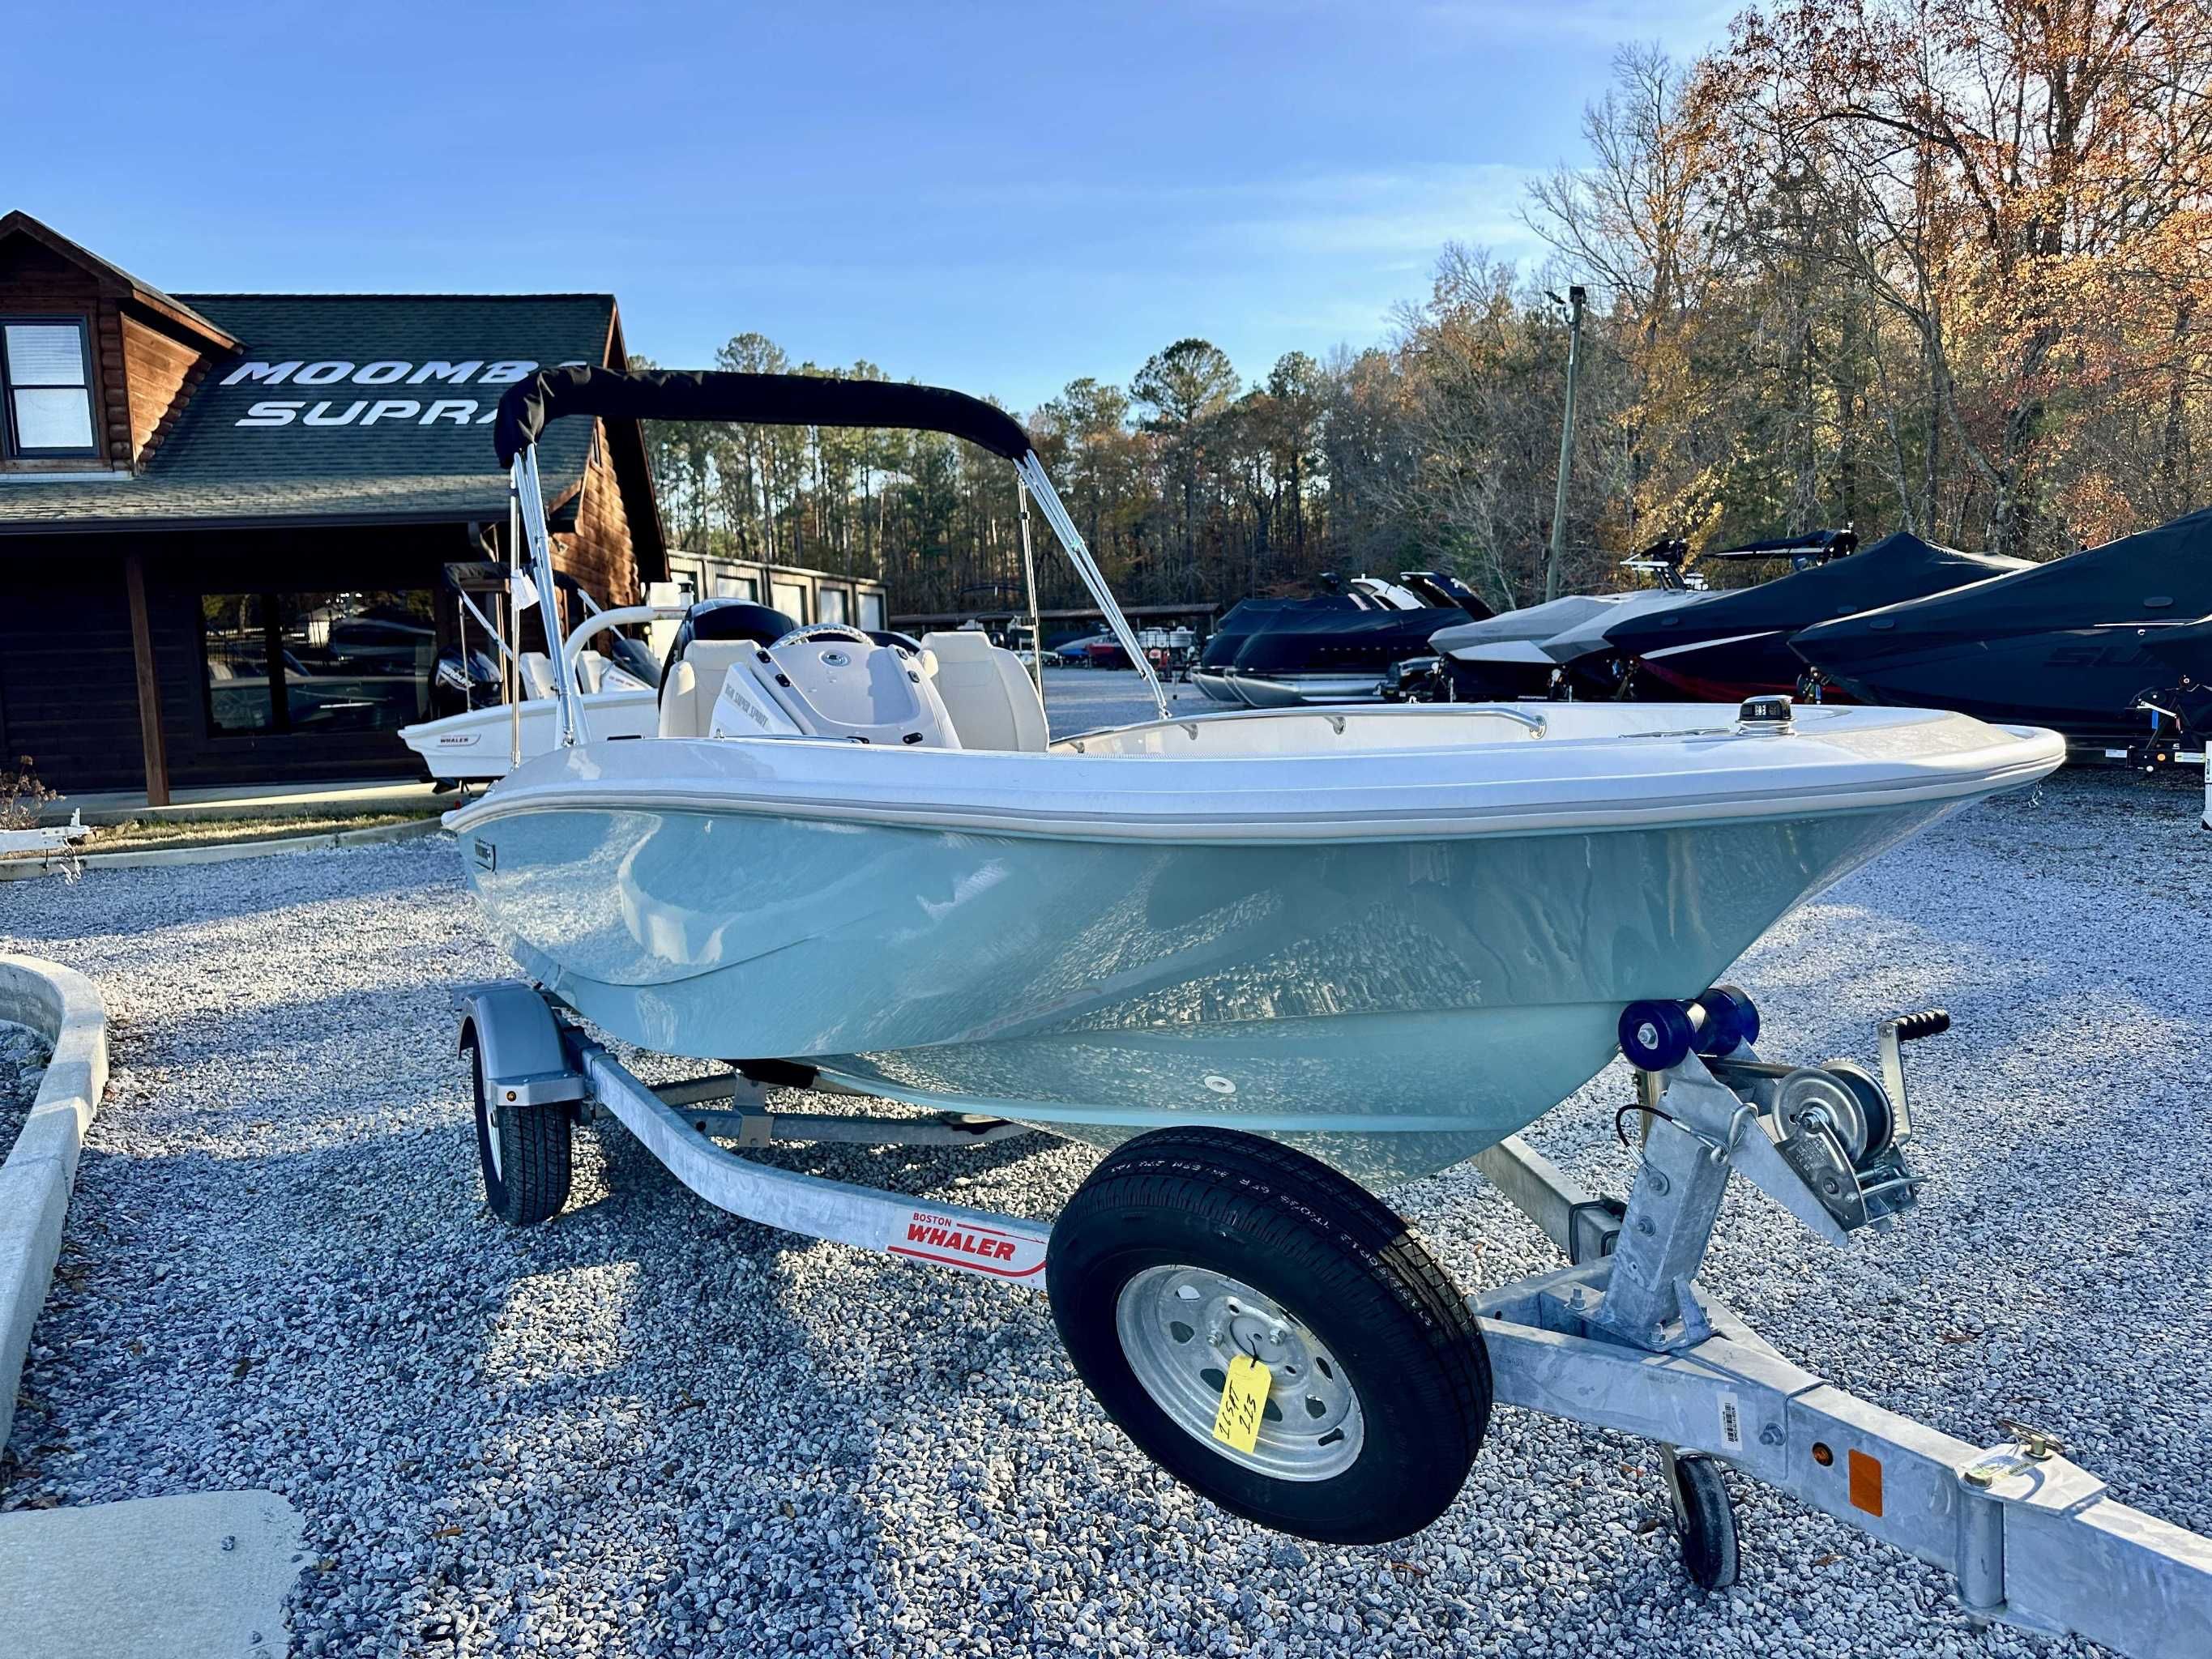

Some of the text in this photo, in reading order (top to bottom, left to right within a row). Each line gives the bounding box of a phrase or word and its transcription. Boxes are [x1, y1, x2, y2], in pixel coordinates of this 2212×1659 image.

[219, 360, 587, 386] MOOMB
[913, 1212, 952, 1227] BOSTON
[907, 1223, 1016, 1261] WHALER
